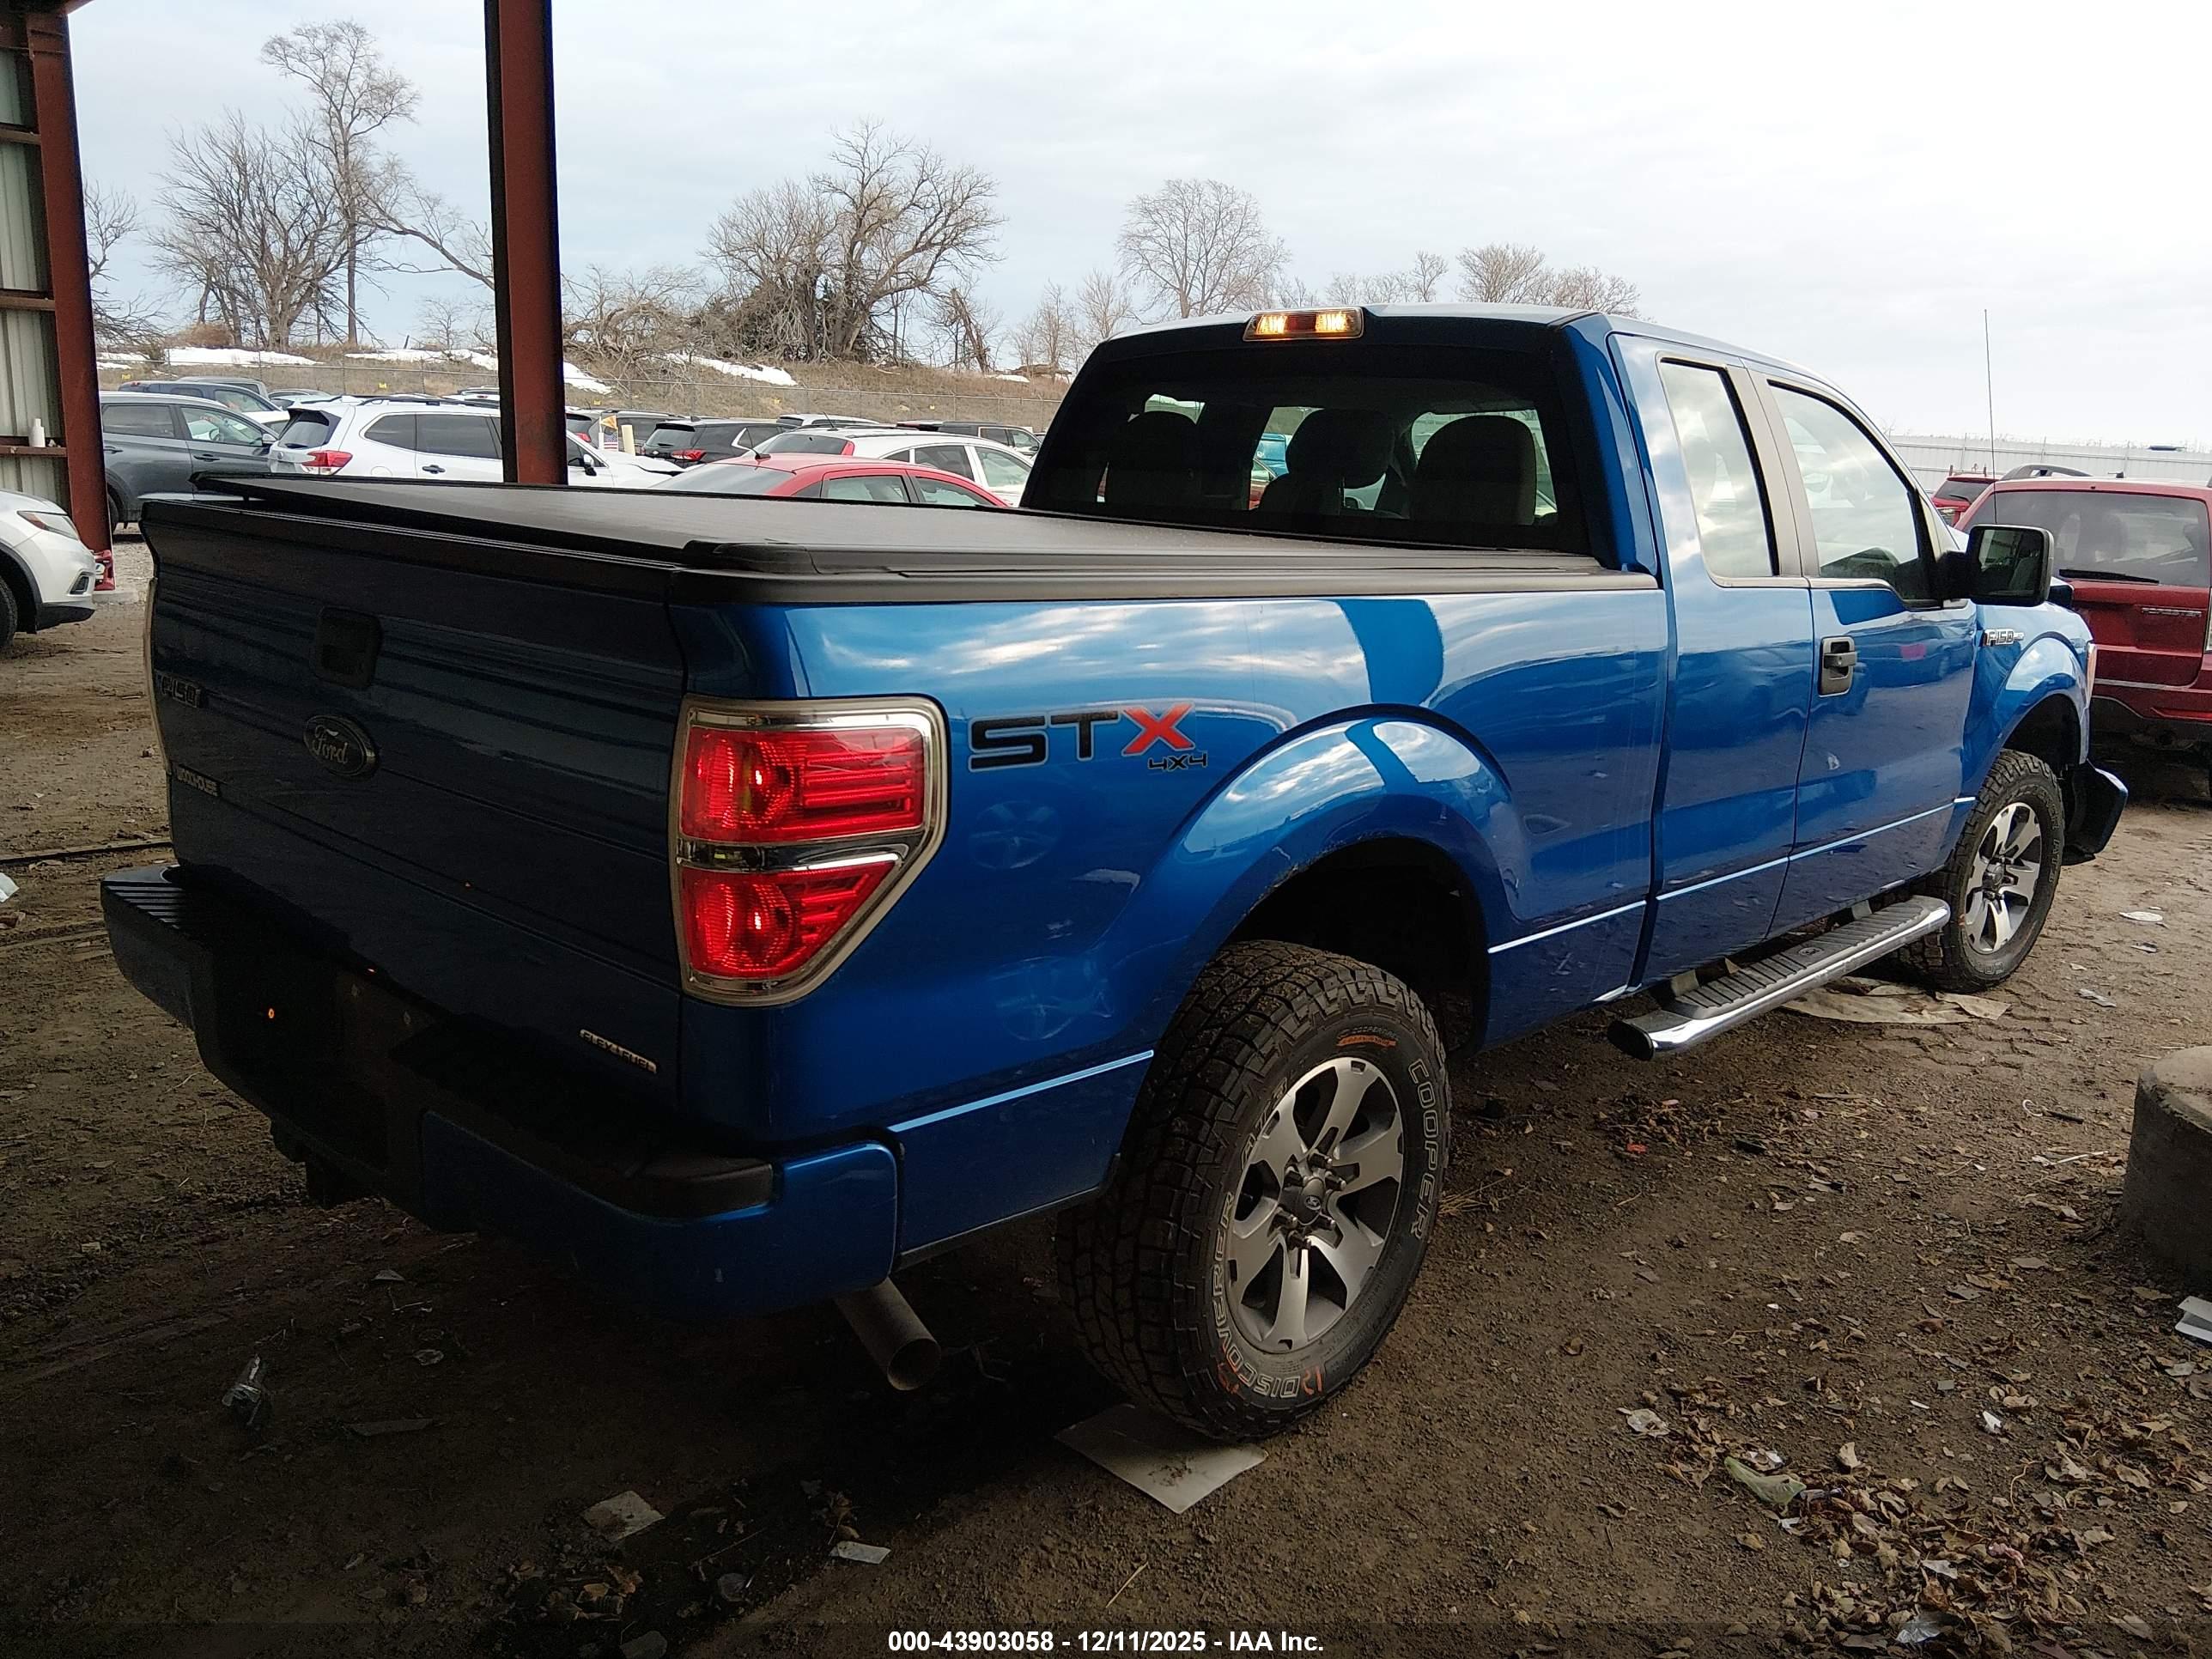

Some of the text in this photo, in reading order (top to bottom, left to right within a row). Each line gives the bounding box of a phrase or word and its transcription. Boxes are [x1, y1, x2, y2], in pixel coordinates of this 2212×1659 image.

[969, 702, 1195, 772] STX
[1408, 1059, 1439, 1240] COOPER
[1212, 1191, 1301, 1399] DISCOVERER
